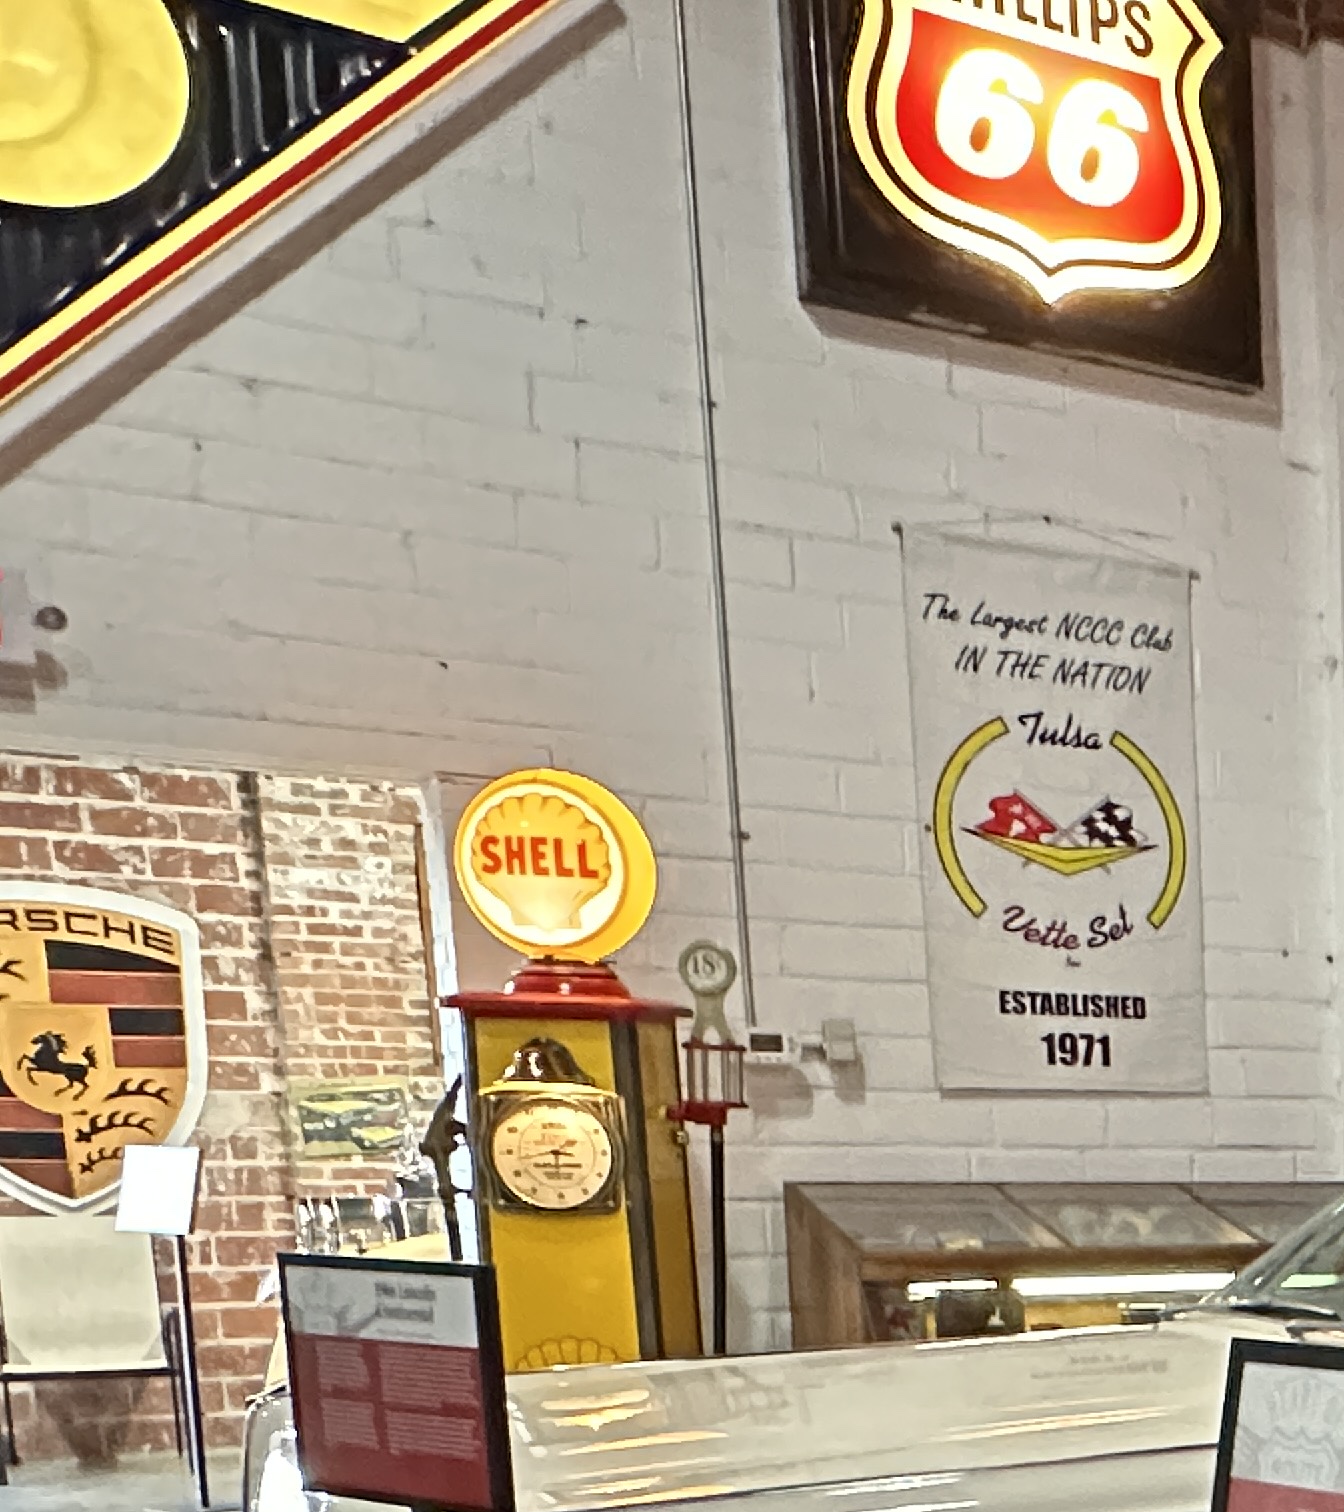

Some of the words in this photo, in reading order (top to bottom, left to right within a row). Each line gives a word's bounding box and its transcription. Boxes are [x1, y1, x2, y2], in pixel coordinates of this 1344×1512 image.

[953, 0, 1154, 57] LLIPS
[935, 48, 1149, 207] 66
[922, 593, 960, 622] The
[970, 602, 1049, 640] Largest
[1055, 613, 1123, 645] NCCC
[1131, 624, 1173, 652] Club
[955, 645, 987, 673] IN
[996, 650, 1050, 680] THE
[1053, 658, 1151, 695] NATION
[1018, 711, 1102, 750] Tulsa
[480, 835, 599, 879] SHELL
[0, 908, 175, 955] RSCHE
[999, 990, 1146, 1019] ESTABLISHED
[1041, 1033, 1111, 1067] 1971
